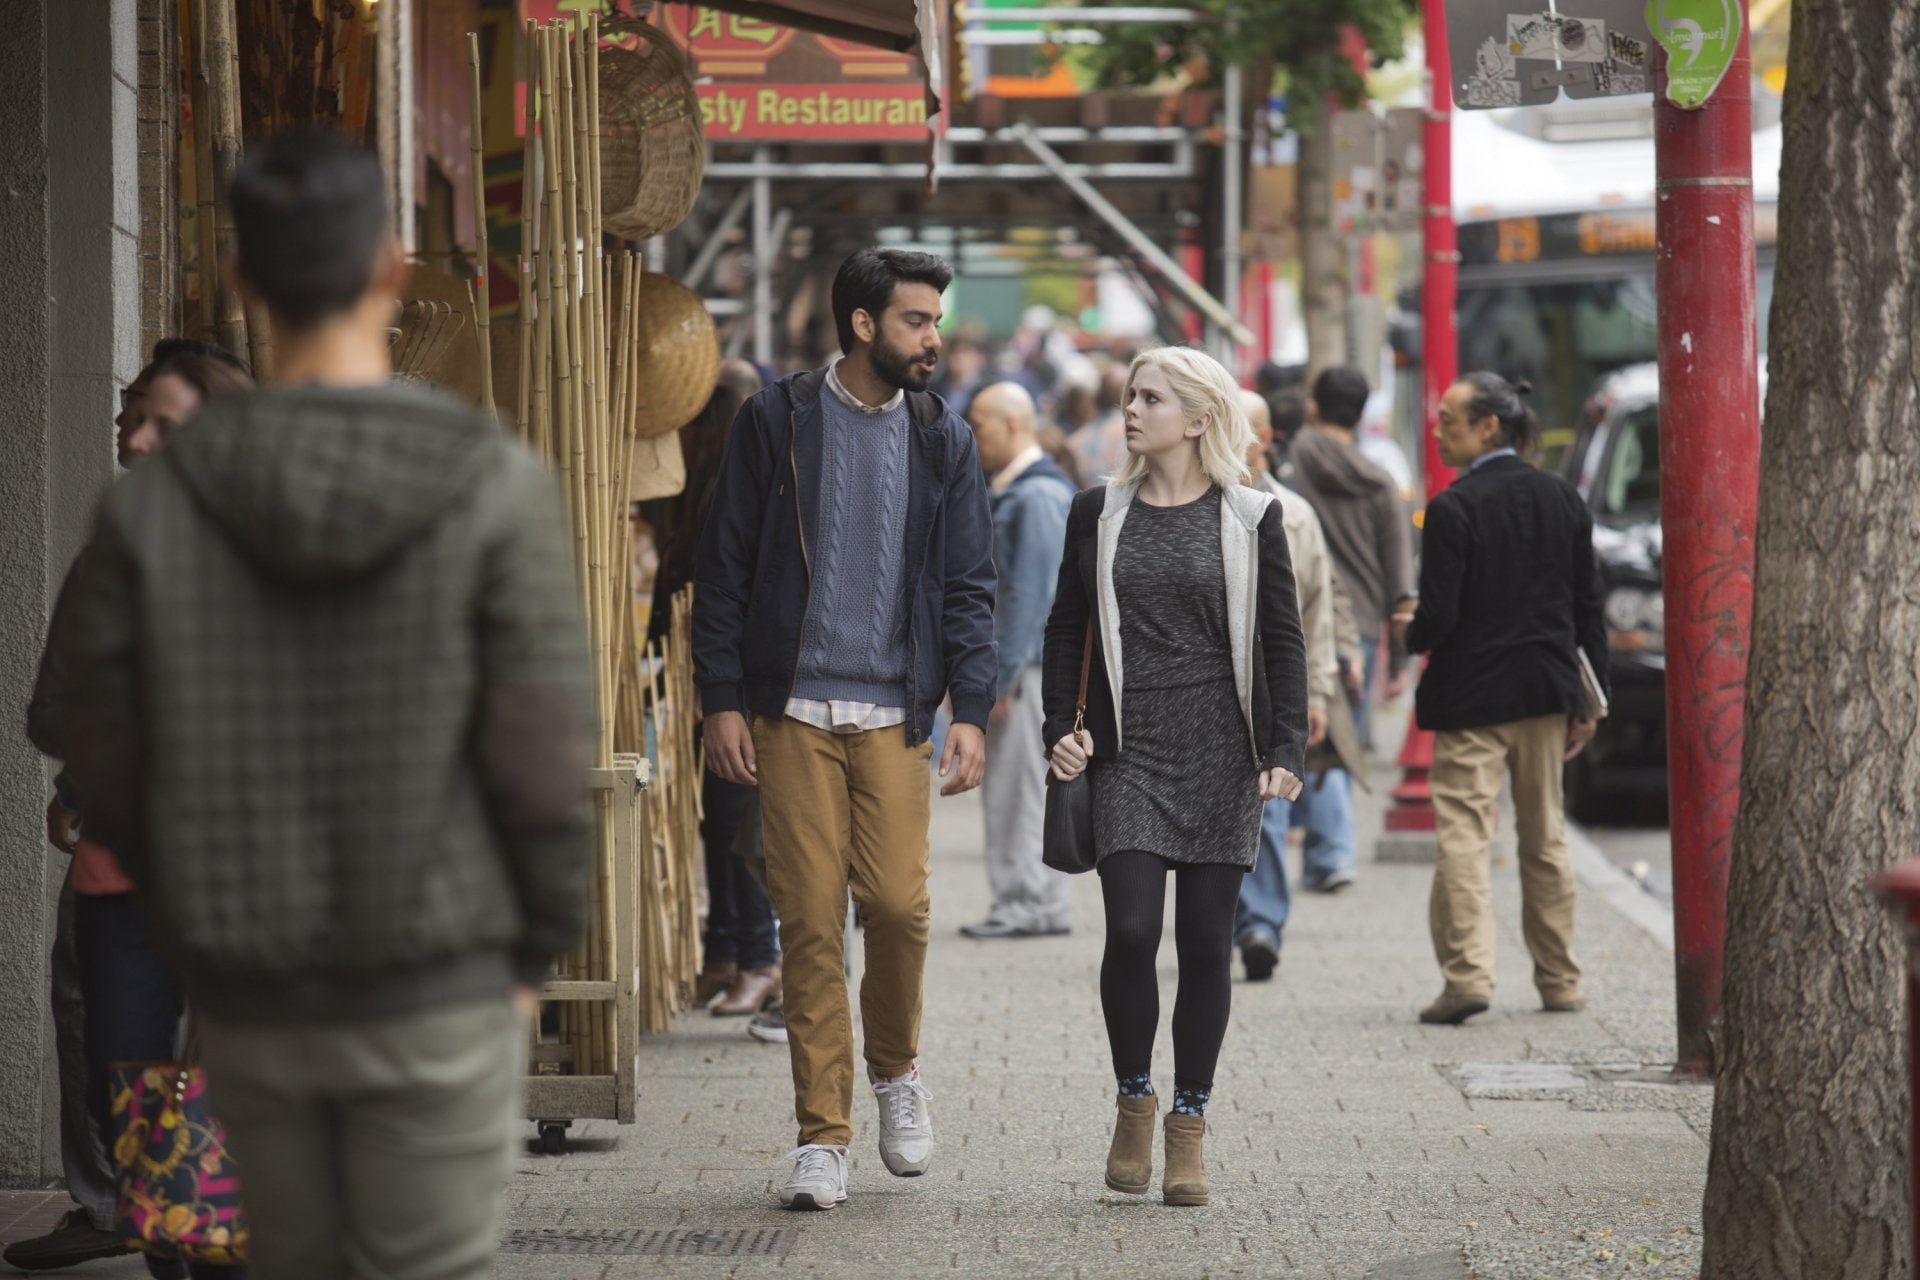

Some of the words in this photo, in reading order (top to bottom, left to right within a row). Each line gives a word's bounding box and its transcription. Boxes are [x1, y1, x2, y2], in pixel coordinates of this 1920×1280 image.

[1669, 27, 1724, 43] [mumur]
[700, 89, 748, 134] sty
[756, 88, 928, 127] Restauran
